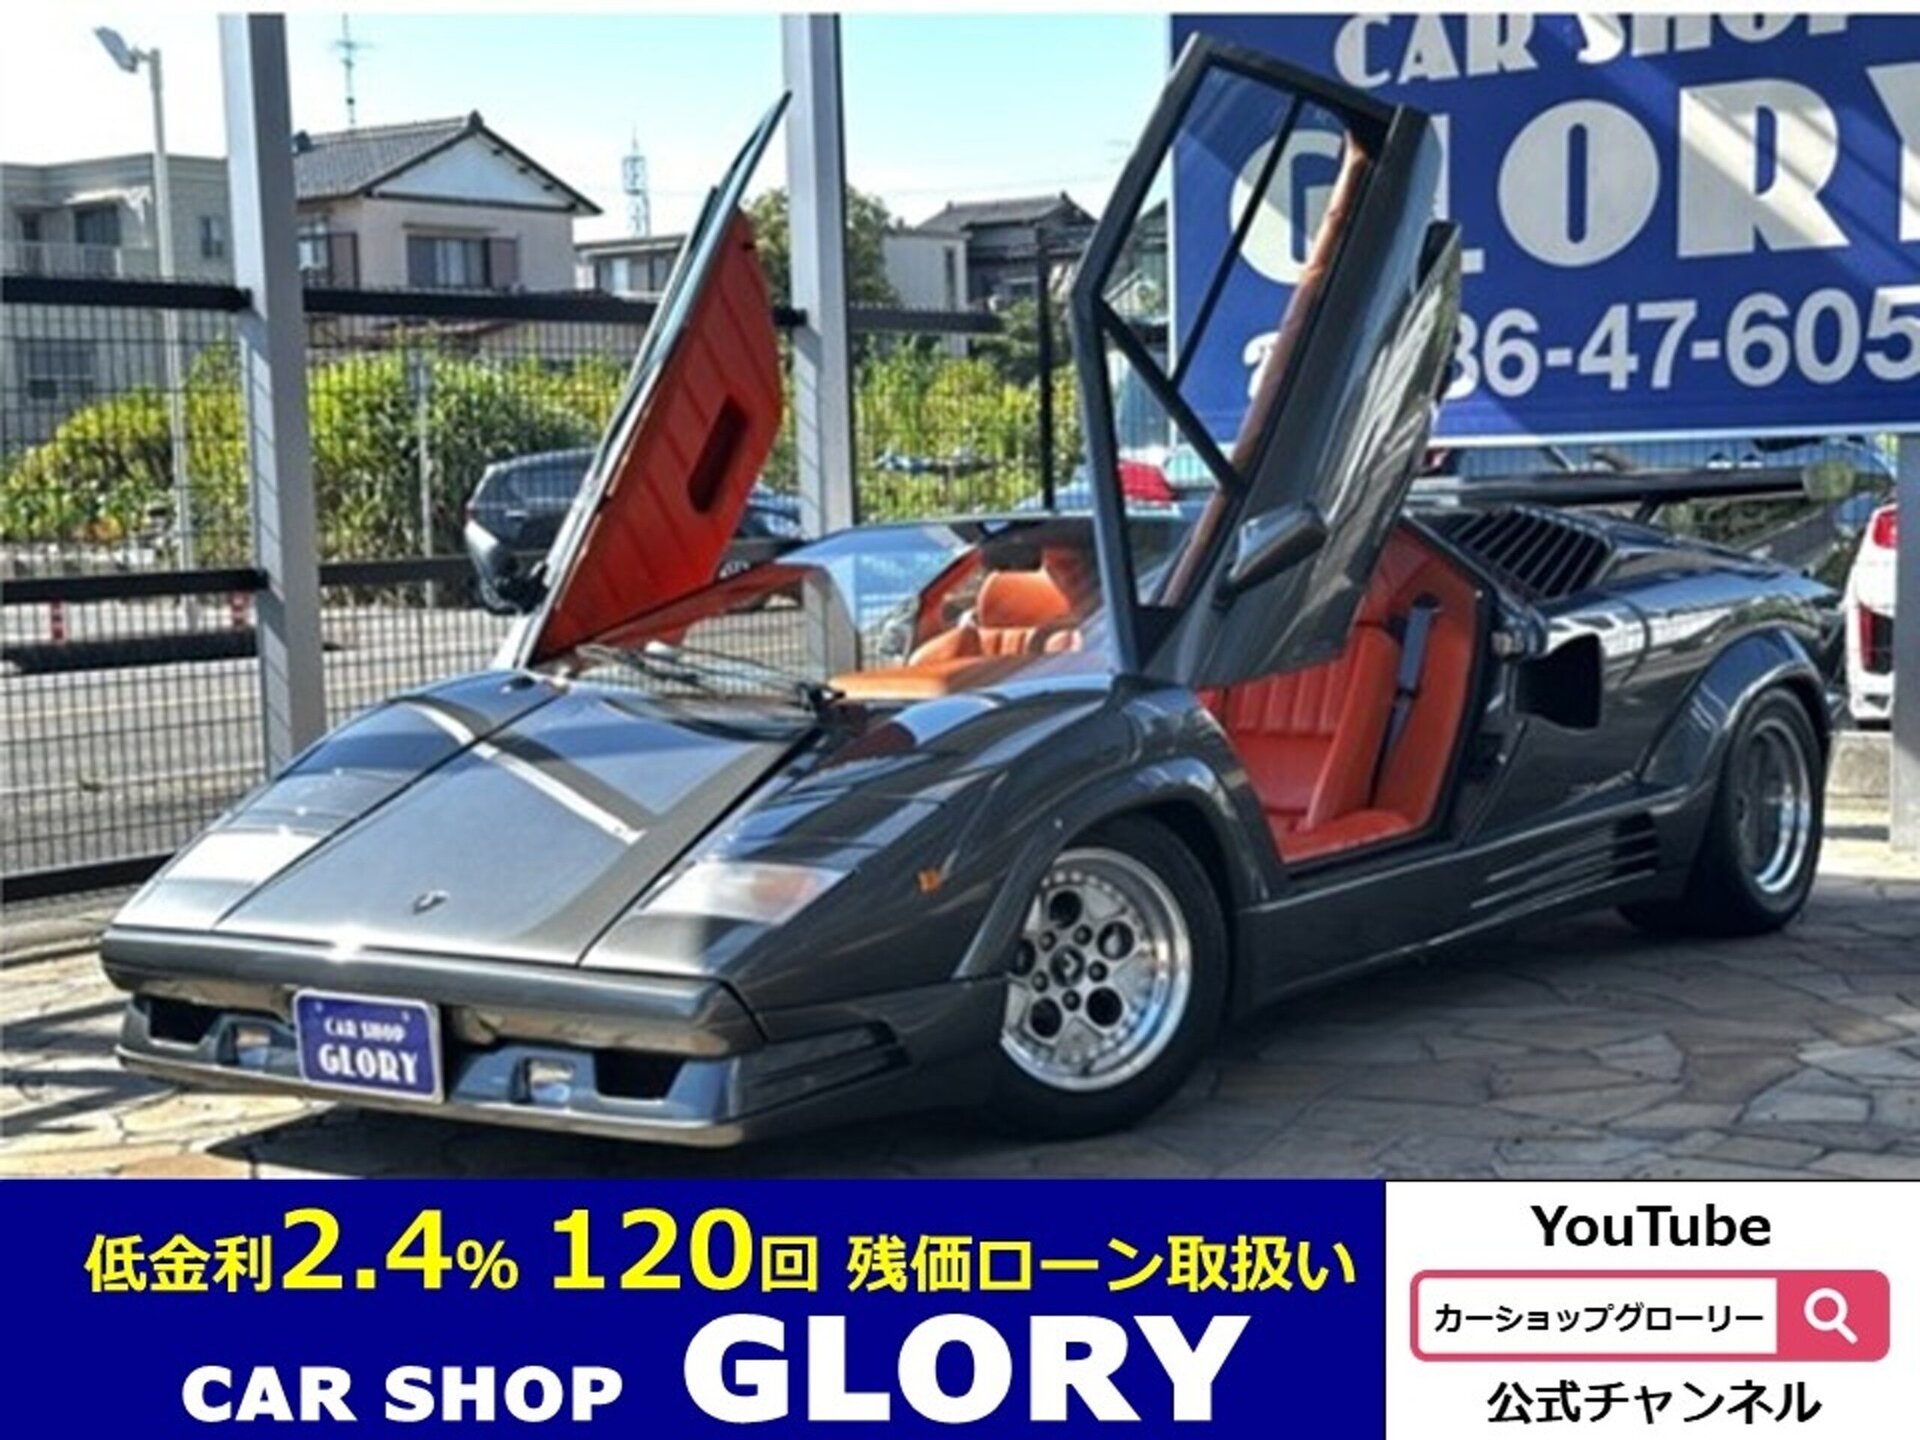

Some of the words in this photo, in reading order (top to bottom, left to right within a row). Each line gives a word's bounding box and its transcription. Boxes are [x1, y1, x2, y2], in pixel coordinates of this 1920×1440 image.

[1333, 14, 1539, 89] CAR
[1577, 14, 1848, 63] SH
[323, 1016, 357, 1039] CAR
[361, 1020, 406, 1043] SHOP
[318, 1043, 418, 1085] GLORY
